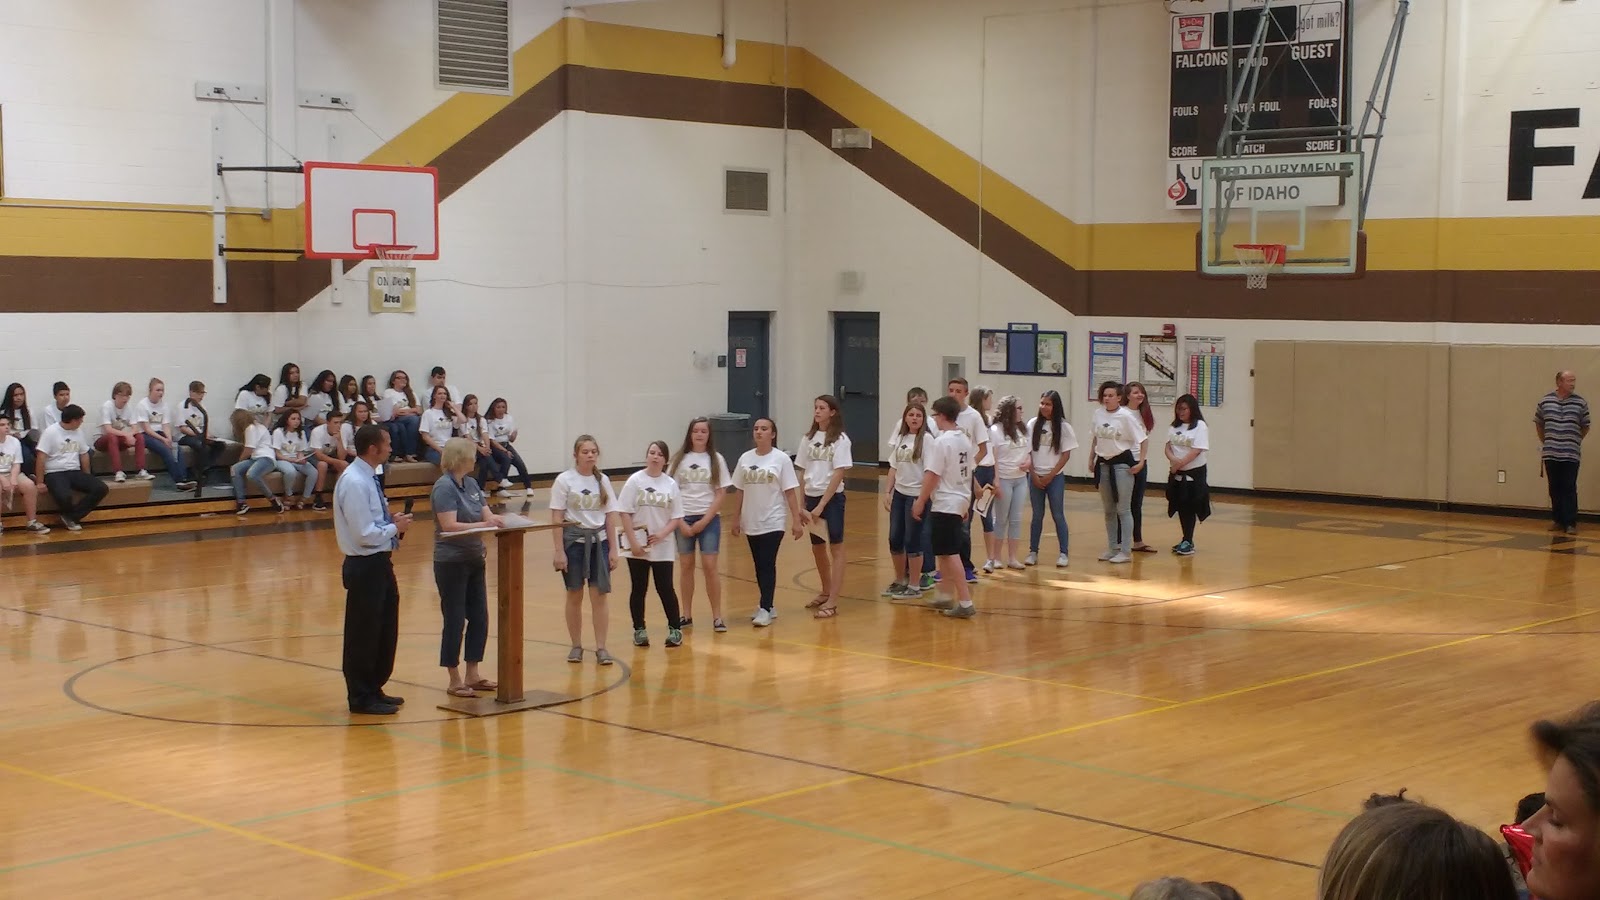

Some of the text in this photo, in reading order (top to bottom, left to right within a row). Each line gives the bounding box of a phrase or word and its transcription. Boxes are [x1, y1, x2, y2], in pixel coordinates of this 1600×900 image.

[1300, 12, 1340, 33] got milk?
[1291, 43, 1334, 60] GUEST
[1175, 51, 1228, 68] FALCONS
[1259, 101, 1281, 112] FOUL
[1308, 97, 1338, 109] FOULS
[1172, 105, 1199, 117] FOULS
[1171, 146, 1197, 157] SCORE
[1306, 140, 1335, 151] SCORE
[1224, 185, 1300, 201] OF IDAHO
[383, 293, 400, 303] Area
